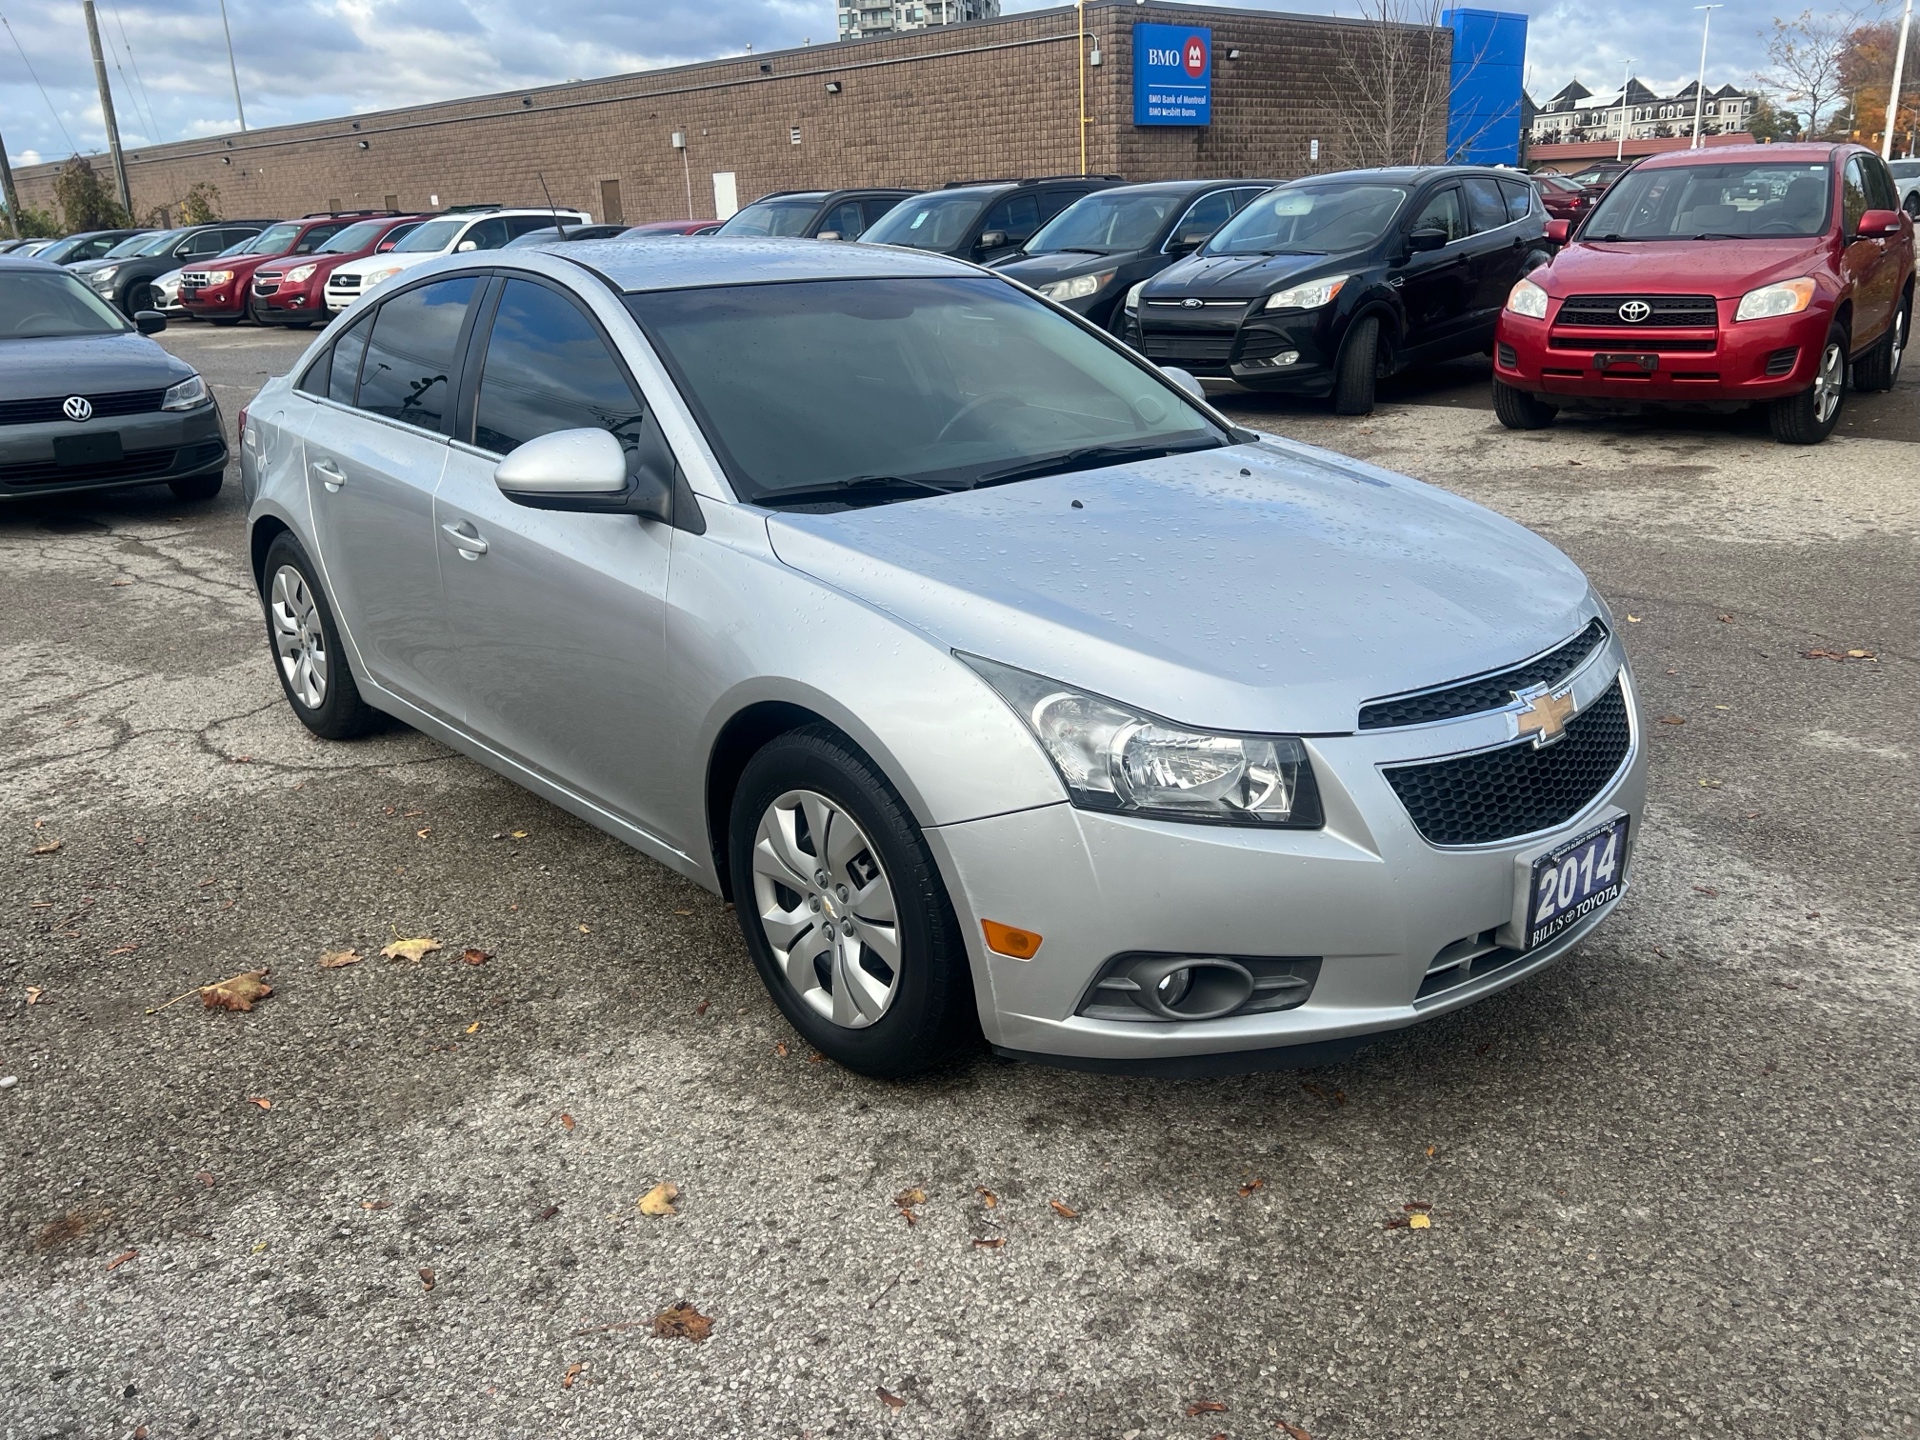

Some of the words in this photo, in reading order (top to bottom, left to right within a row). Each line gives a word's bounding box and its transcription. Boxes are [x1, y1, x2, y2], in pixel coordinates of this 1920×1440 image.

[1148, 49, 1180, 66] BMO
[1148, 94, 1161, 103] BMO
[1162, 94, 1176, 104] Bank
[1176, 95, 1183, 104] of
[1183, 95, 1206, 104] Montreal
[1148, 107, 1161, 115] BMO
[1162, 107, 1181, 116] Nesbitt
[1586, 829, 1601, 840] TOYOTA
[1600, 821, 1616, 833] DEAER
[1535, 832, 1617, 924] 2014
[1531, 913, 1564, 948] BILL'S
[1576, 884, 1618, 918] TOYOTA
